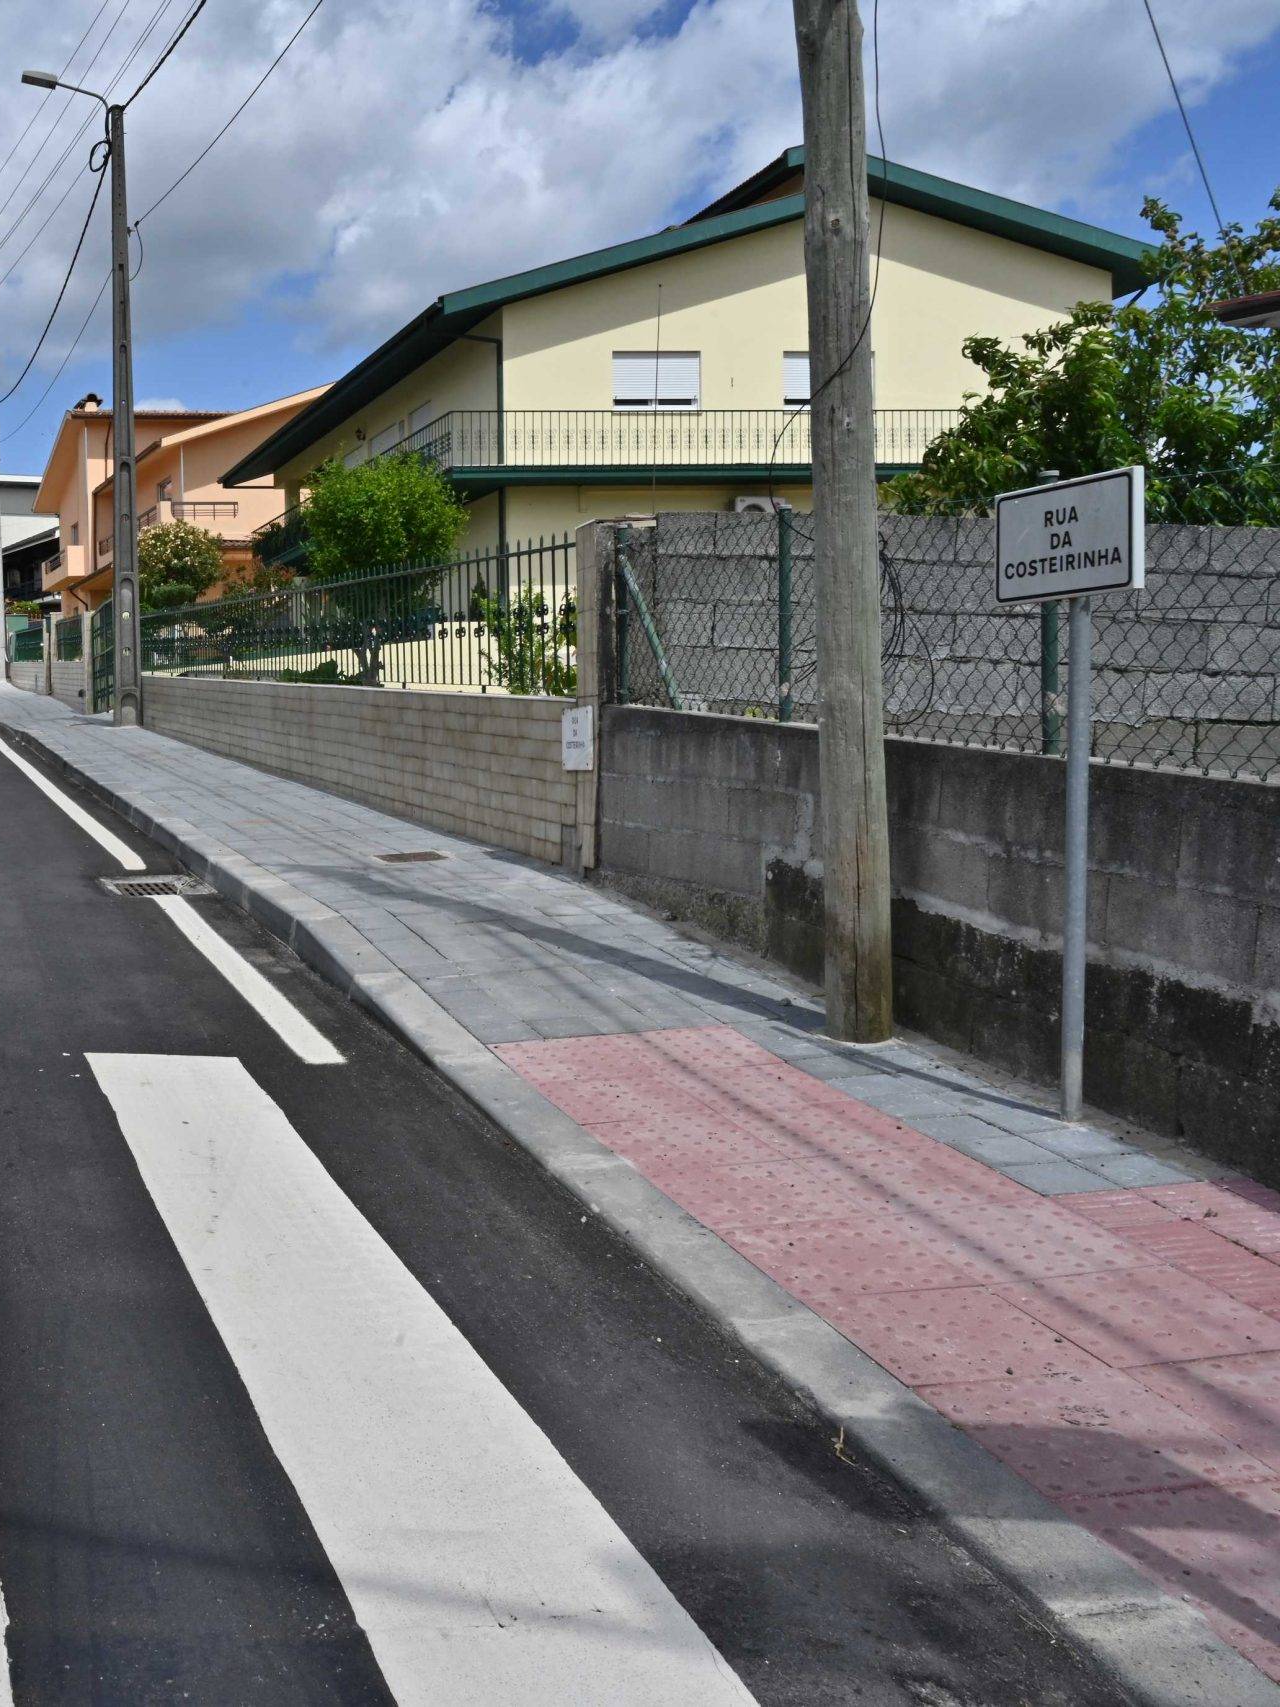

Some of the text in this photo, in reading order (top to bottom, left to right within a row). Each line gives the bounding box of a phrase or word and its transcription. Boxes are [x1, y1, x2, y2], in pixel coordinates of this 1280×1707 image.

[1044, 506, 1079, 527] RUA
[1050, 531, 1072, 550] DA
[1005, 547, 1122, 580] COSTEIRINHA
